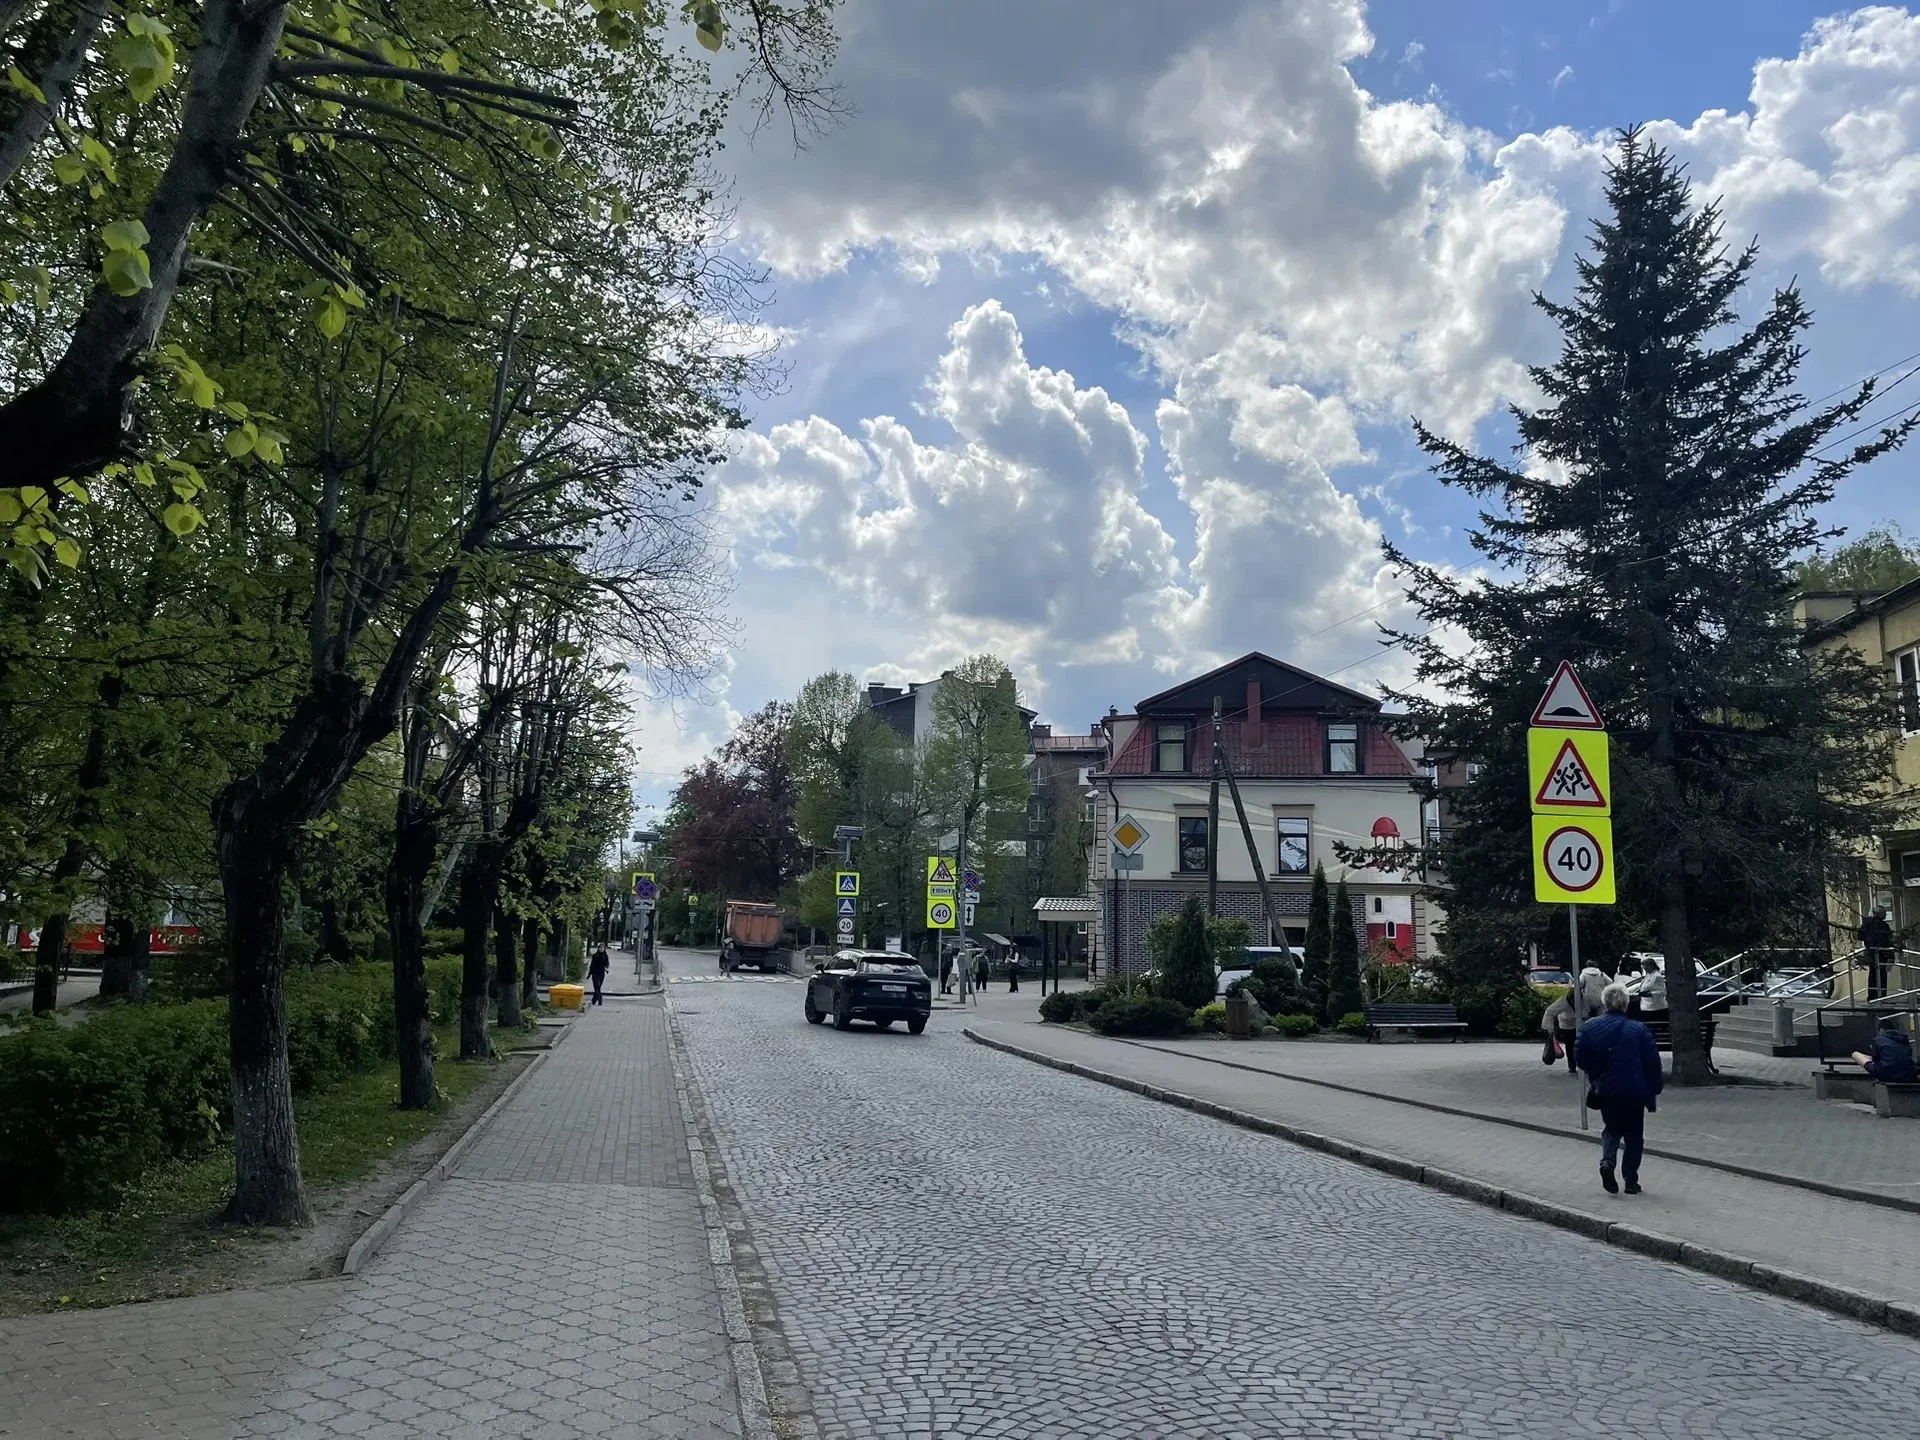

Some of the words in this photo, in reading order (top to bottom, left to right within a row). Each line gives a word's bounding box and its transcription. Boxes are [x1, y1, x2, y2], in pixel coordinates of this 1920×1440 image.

[1557, 846, 1592, 872] 40
[935, 909, 948, 918] 40
[841, 921, 851, 929] 20
